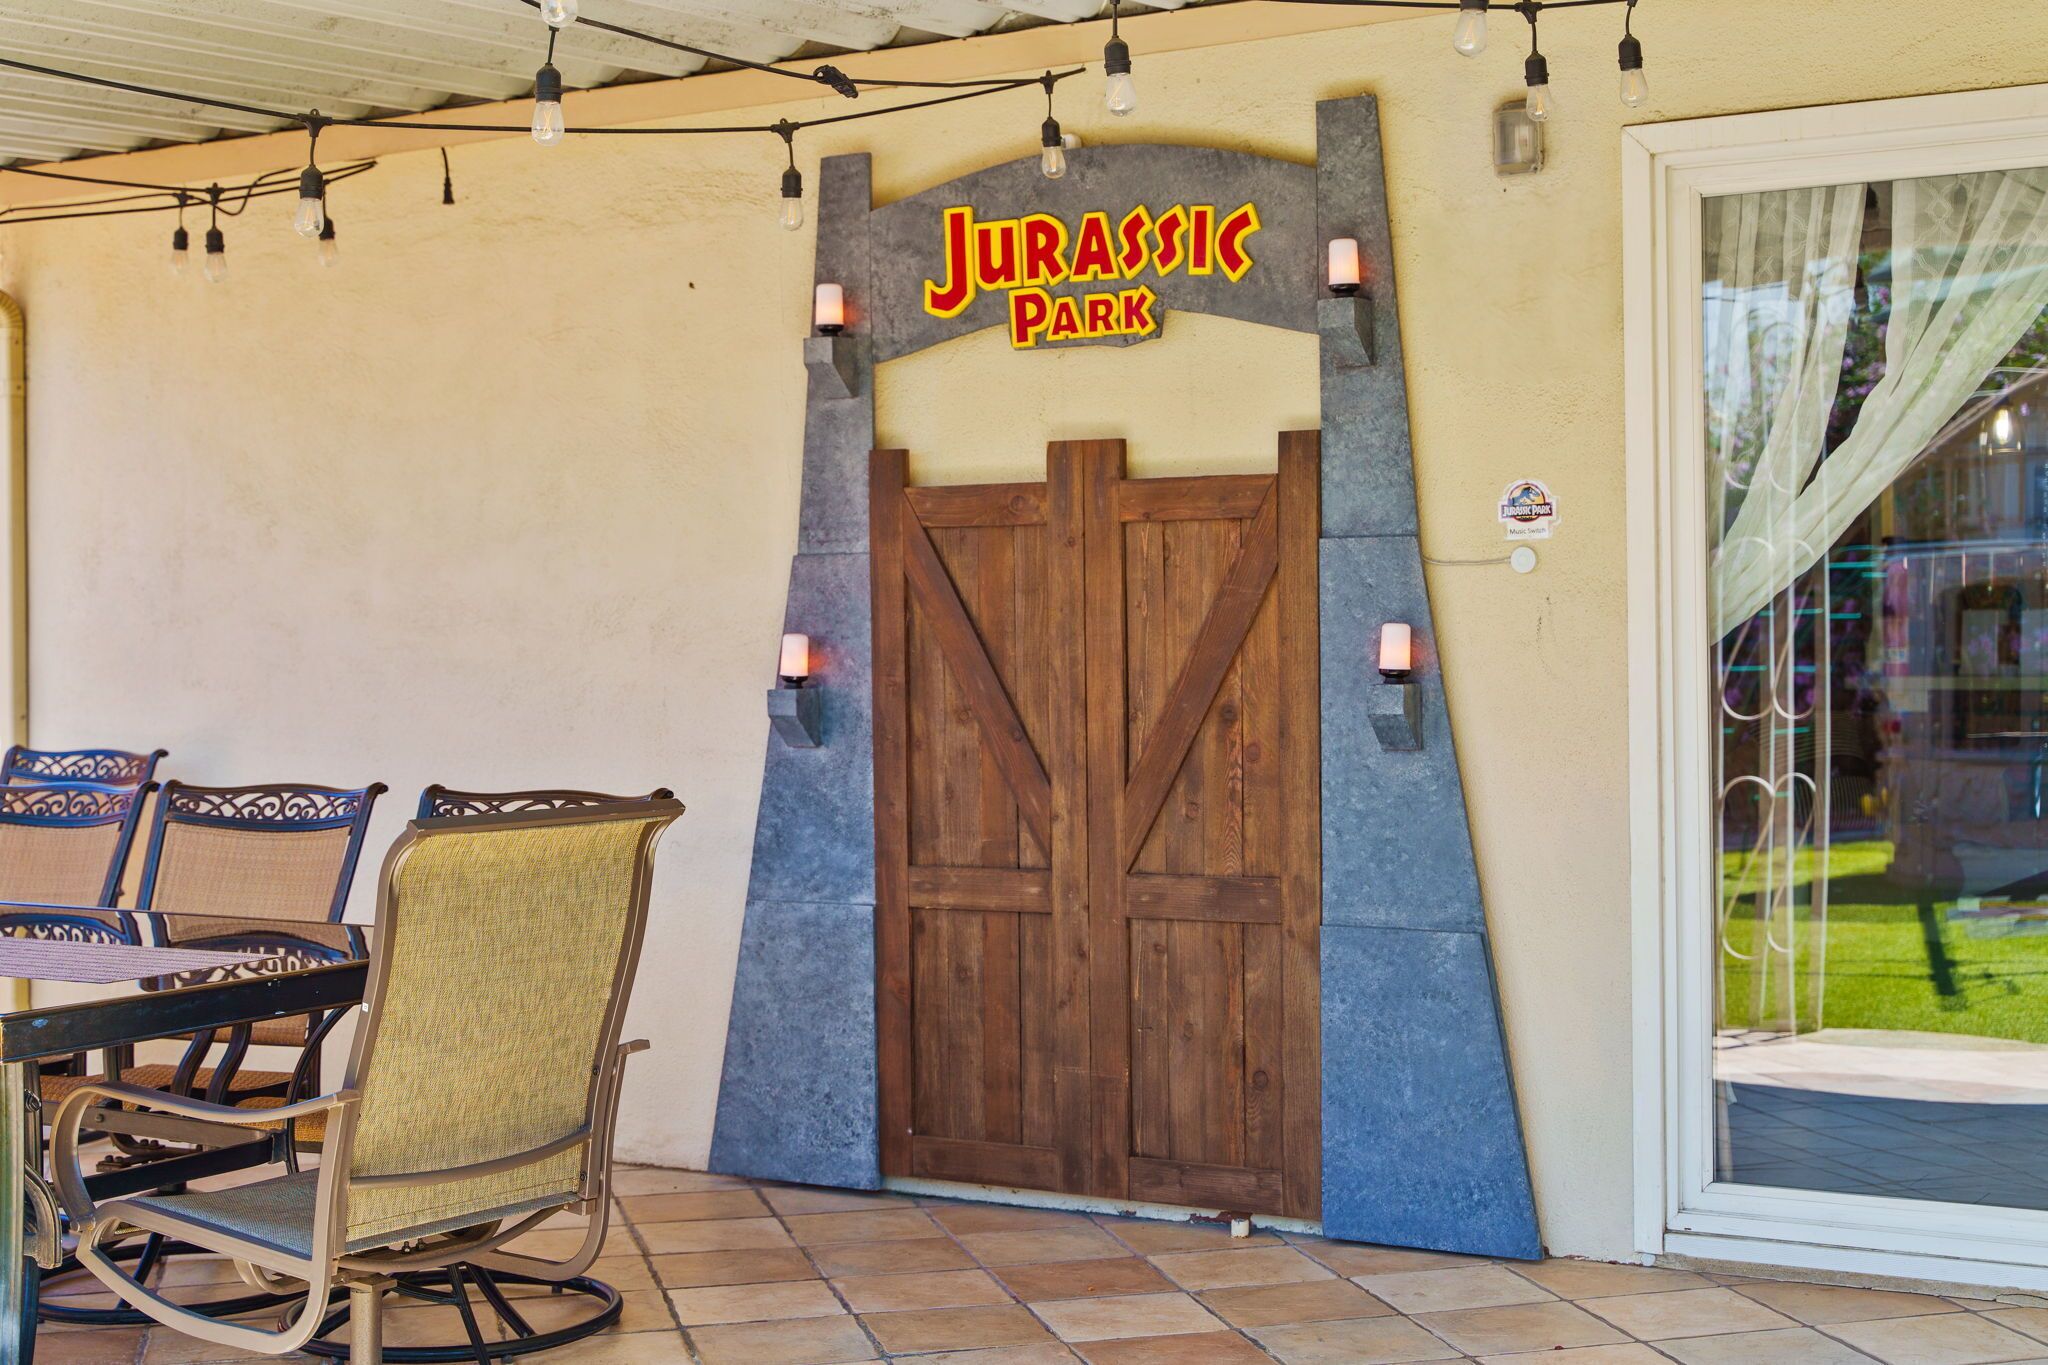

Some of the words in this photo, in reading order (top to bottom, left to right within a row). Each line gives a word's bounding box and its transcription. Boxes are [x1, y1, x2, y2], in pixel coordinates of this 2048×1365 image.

[924, 202, 1261, 318] JURASSIC
[1009, 284, 1157, 348] PARK
[1503, 506, 1531, 516] JURASSIC
[1532, 505, 1551, 515] PARK
